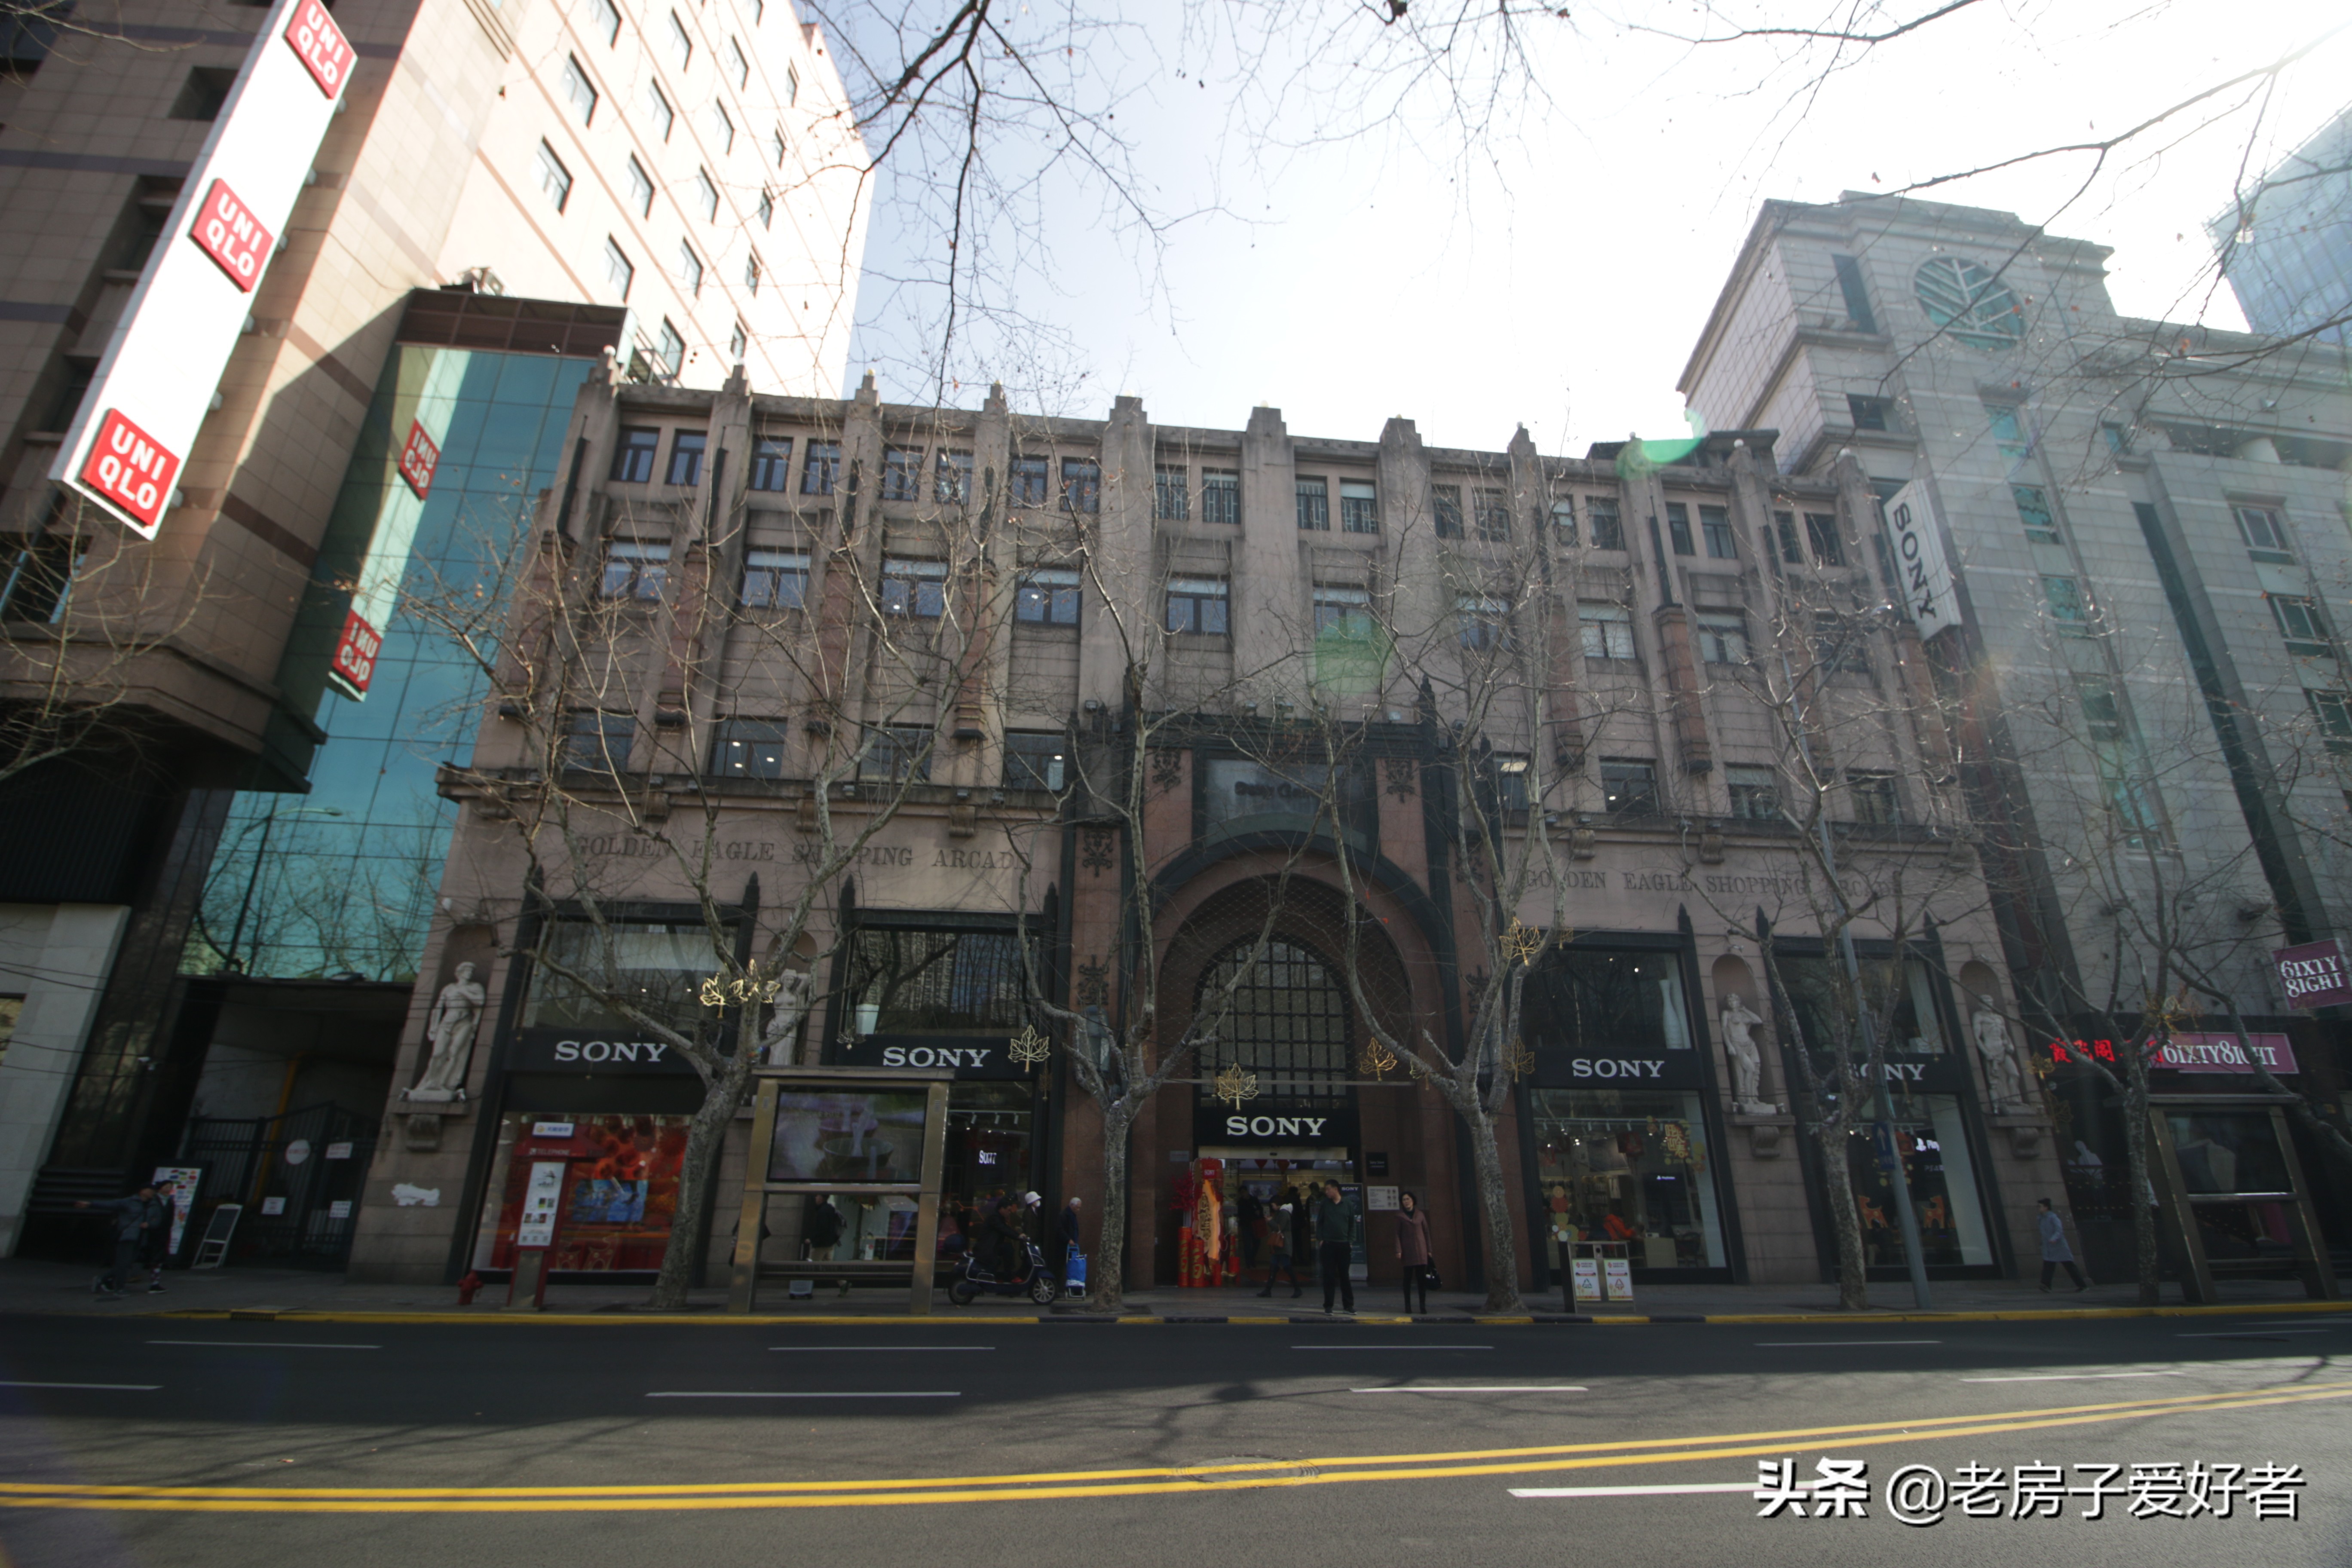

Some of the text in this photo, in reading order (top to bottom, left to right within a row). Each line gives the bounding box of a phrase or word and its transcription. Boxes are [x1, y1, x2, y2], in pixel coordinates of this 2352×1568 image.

[306, 3, 344, 64] UNI
[297, 25, 338, 85] QLO
[217, 193, 262, 252] UNI
[206, 219, 254, 277] QLO
[111, 423, 167, 479] UNI
[98, 455, 157, 512] QLO
[1893, 502, 1936, 619] SONY
[792, 844, 913, 866] SHPING
[1525, 869, 1606, 888] GODEN
[1622, 872, 1692, 891] EAGLE
[2280, 956, 2338, 979] 6IXTY
[2285, 972, 2343, 994] 8IGHT
[554, 1041, 668, 1062] SONY
[883, 1047, 991, 1067] SONY
[1571, 1058, 1665, 1078] SONY
[1226, 1115, 1326, 1136] SONY
